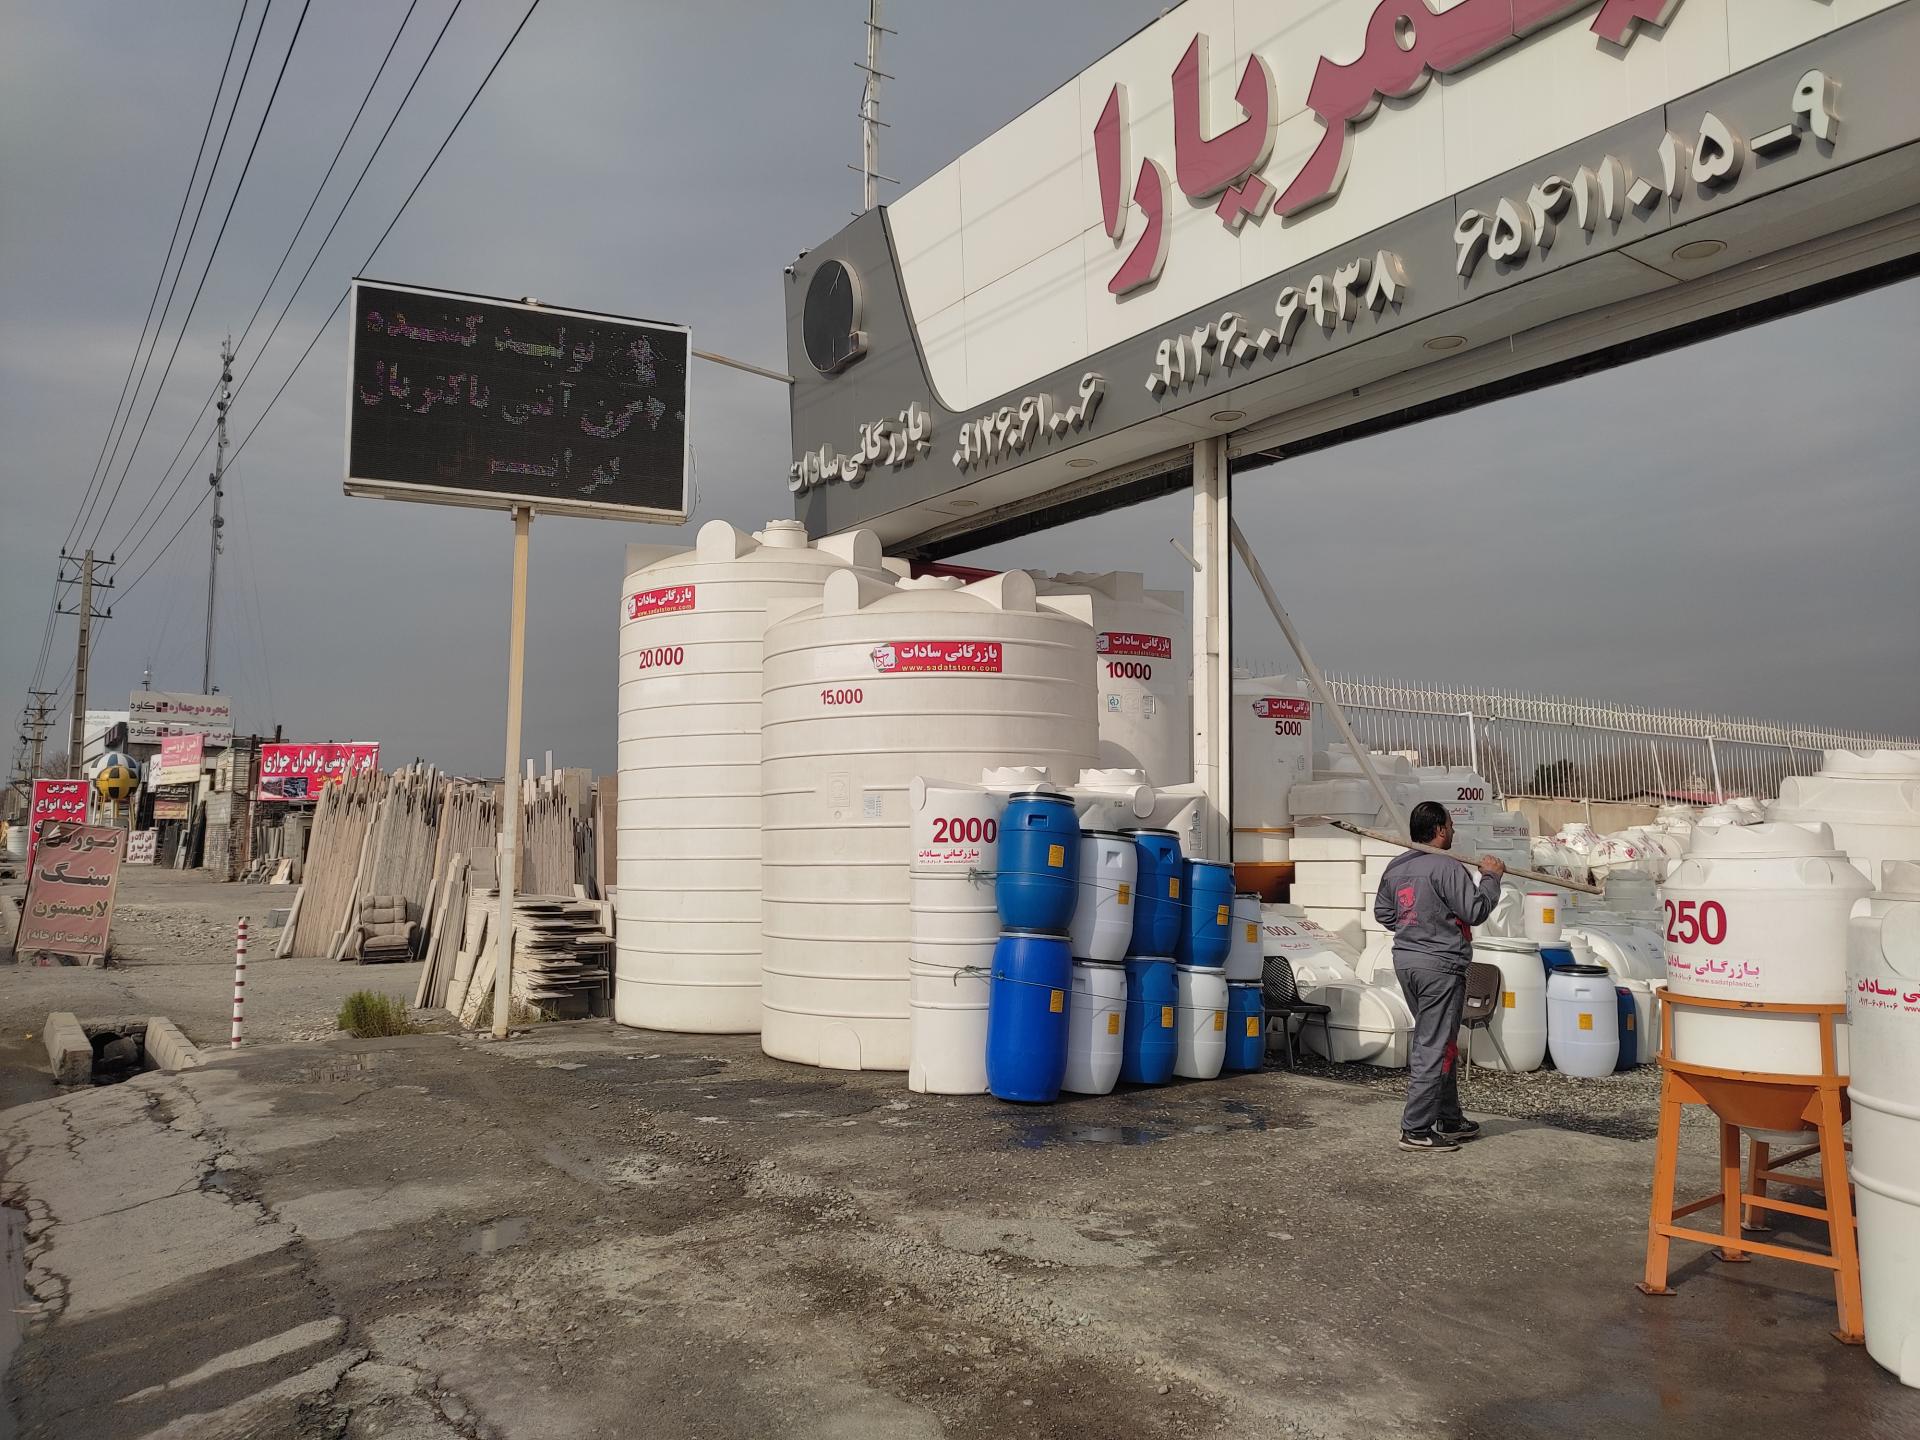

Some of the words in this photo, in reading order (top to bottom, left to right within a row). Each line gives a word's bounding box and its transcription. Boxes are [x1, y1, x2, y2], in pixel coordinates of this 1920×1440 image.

[1094, 33, 1279, 297] یارا
[841, 401, 932, 482] بازرگانی
[788, 443, 850, 493] سادات
[637, 593, 657, 606] سادات
[658, 588, 692, 606] بازرگانی
[1113, 635, 1140, 645] سادات
[1141, 636, 1170, 652] بازرگانی
[901, 644, 942, 658] سادات
[945, 644, 998, 662] بازرگانی
[901, 664, 998, 672] www.sadatstore.com
[1106, 662, 1151, 680] 10000
[130, 700, 156, 712] کاوه
[206, 705, 229, 717] پنجره
[1272, 700, 1293, 709] سادات
[130, 726, 156, 737] کاوه
[1275, 721, 1302, 736] 5000
[263, 750, 290, 773] جوازی
[291, 750, 325, 773] برادران
[47, 784, 78, 794] بهترین
[1457, 787, 1484, 800] 2000
[36, 798, 61, 813] انواع
[62, 799, 85, 814] خرید
[933, 817, 997, 844] 2000
[918, 850, 942, 858] سادات
[944, 848, 980, 860] بازرگانی
[40, 862, 111, 887] سنگ
[32, 901, 108, 920] لایمستون
[1665, 899, 1727, 945] 250
[1668, 954, 1692, 969] سادات
[1695, 958, 1760, 979] بازرگانی
[1858, 977, 1896, 996] سادات
